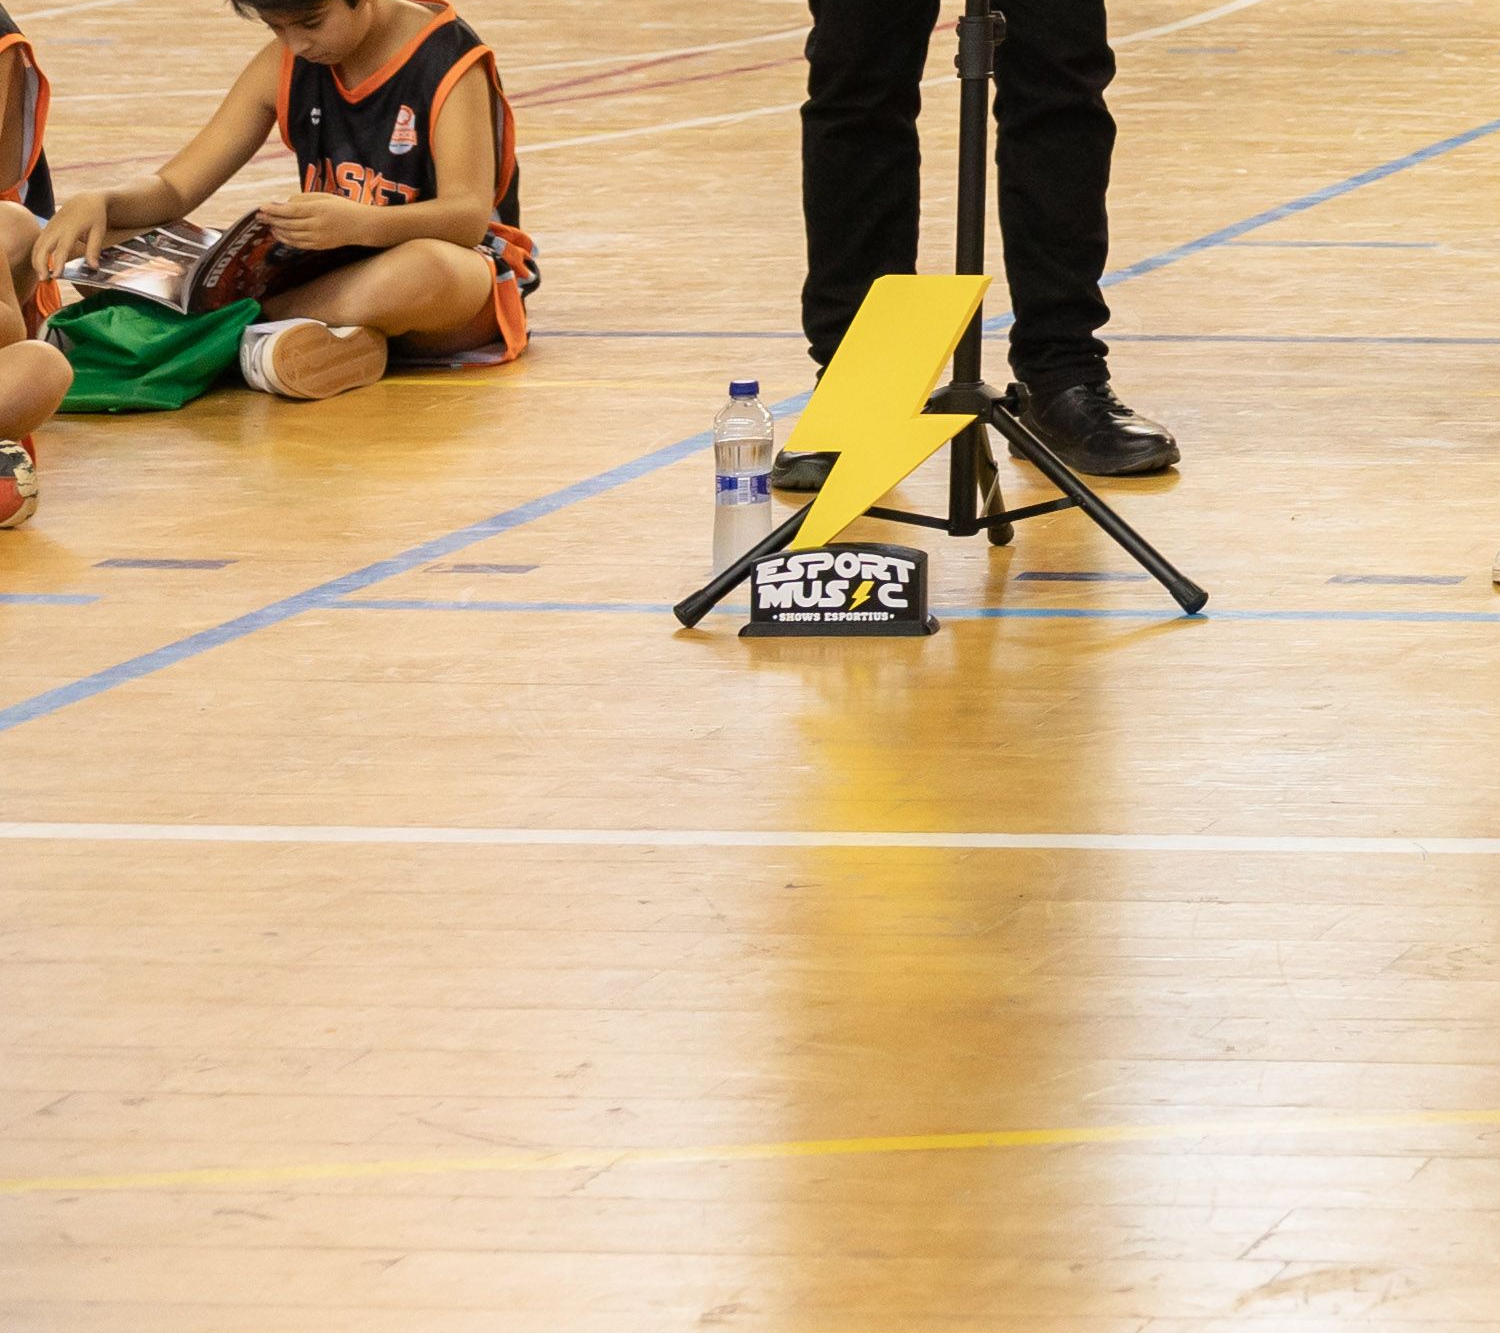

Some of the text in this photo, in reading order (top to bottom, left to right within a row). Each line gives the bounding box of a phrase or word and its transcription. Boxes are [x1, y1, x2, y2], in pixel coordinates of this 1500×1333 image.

[756, 552, 916, 585] ESPORT
[778, 612, 890, 622] SHOWS ESPORTIUS
